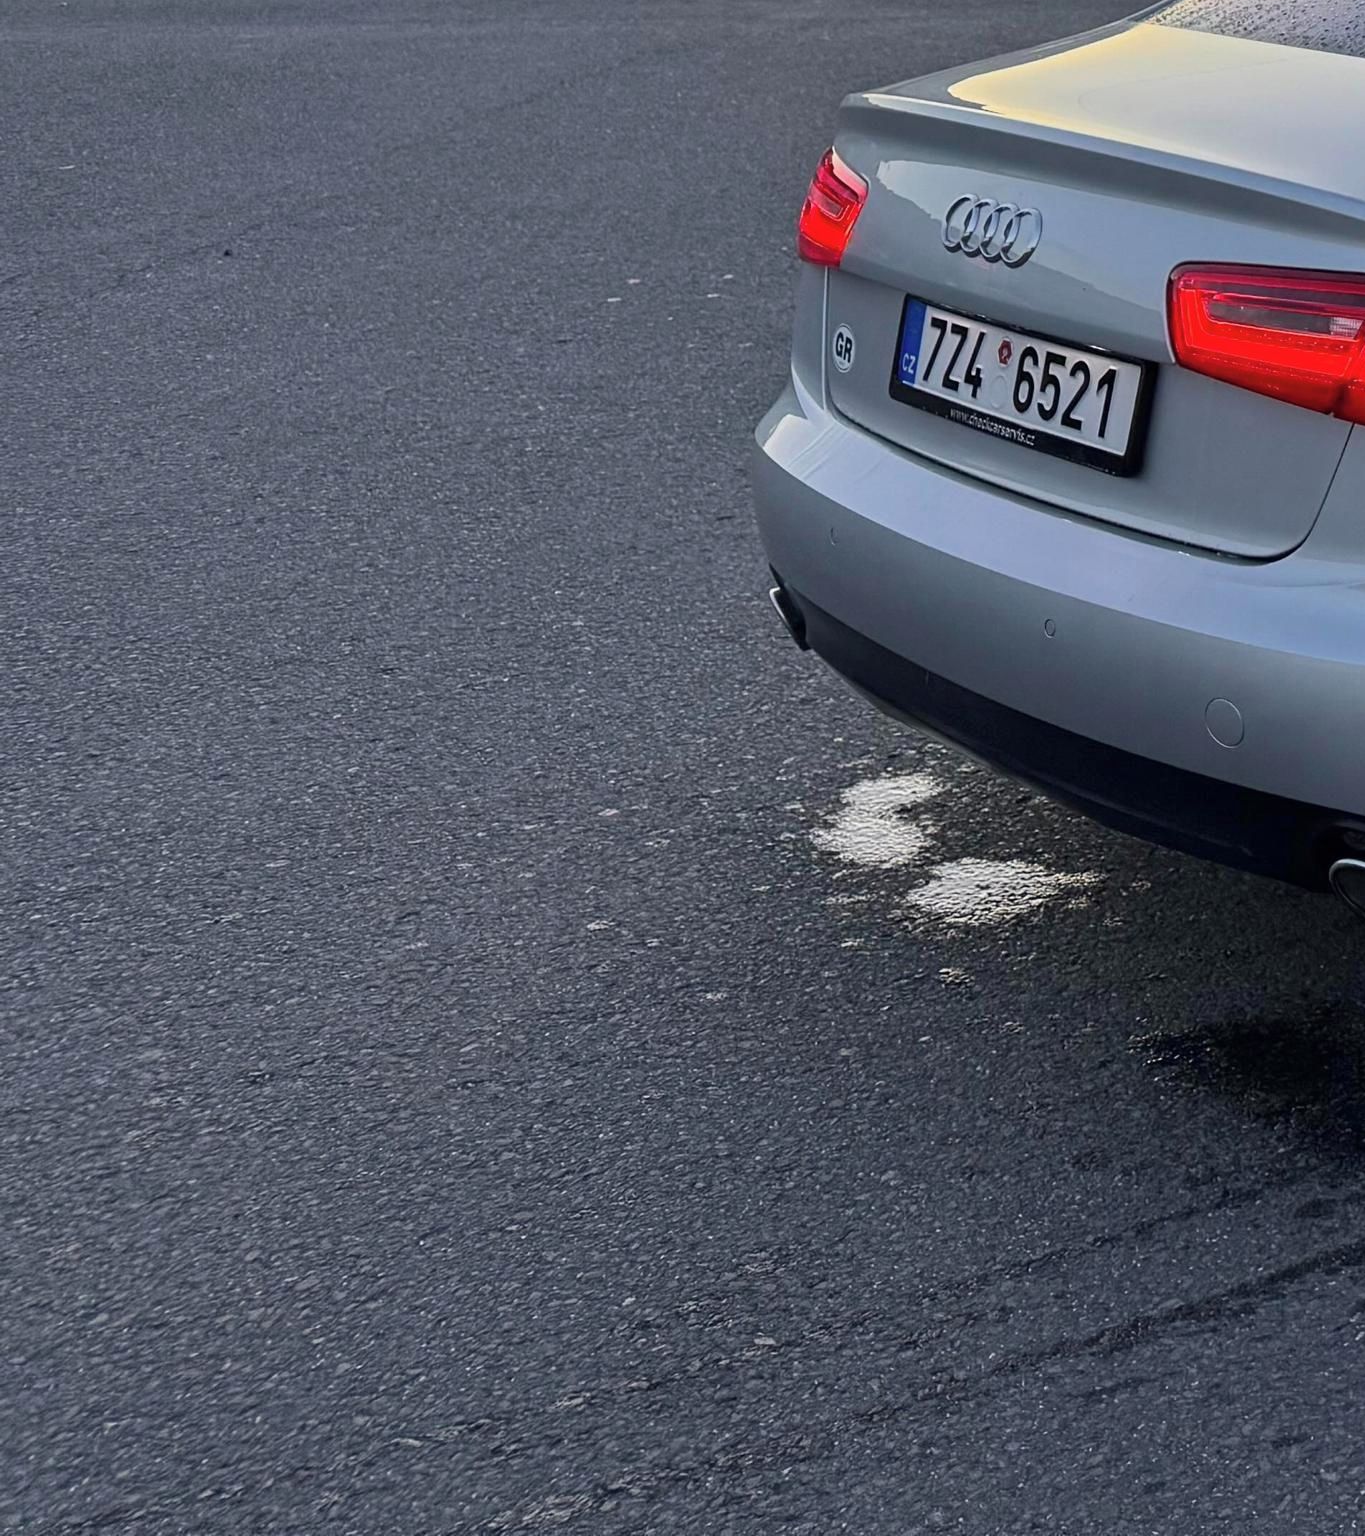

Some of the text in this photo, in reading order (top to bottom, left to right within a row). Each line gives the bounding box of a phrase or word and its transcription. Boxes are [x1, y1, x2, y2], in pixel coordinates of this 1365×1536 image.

[835, 331, 853, 363] GR
[902, 354, 915, 374] CZ
[922, 316, 1117, 439] 7Z4 6521
